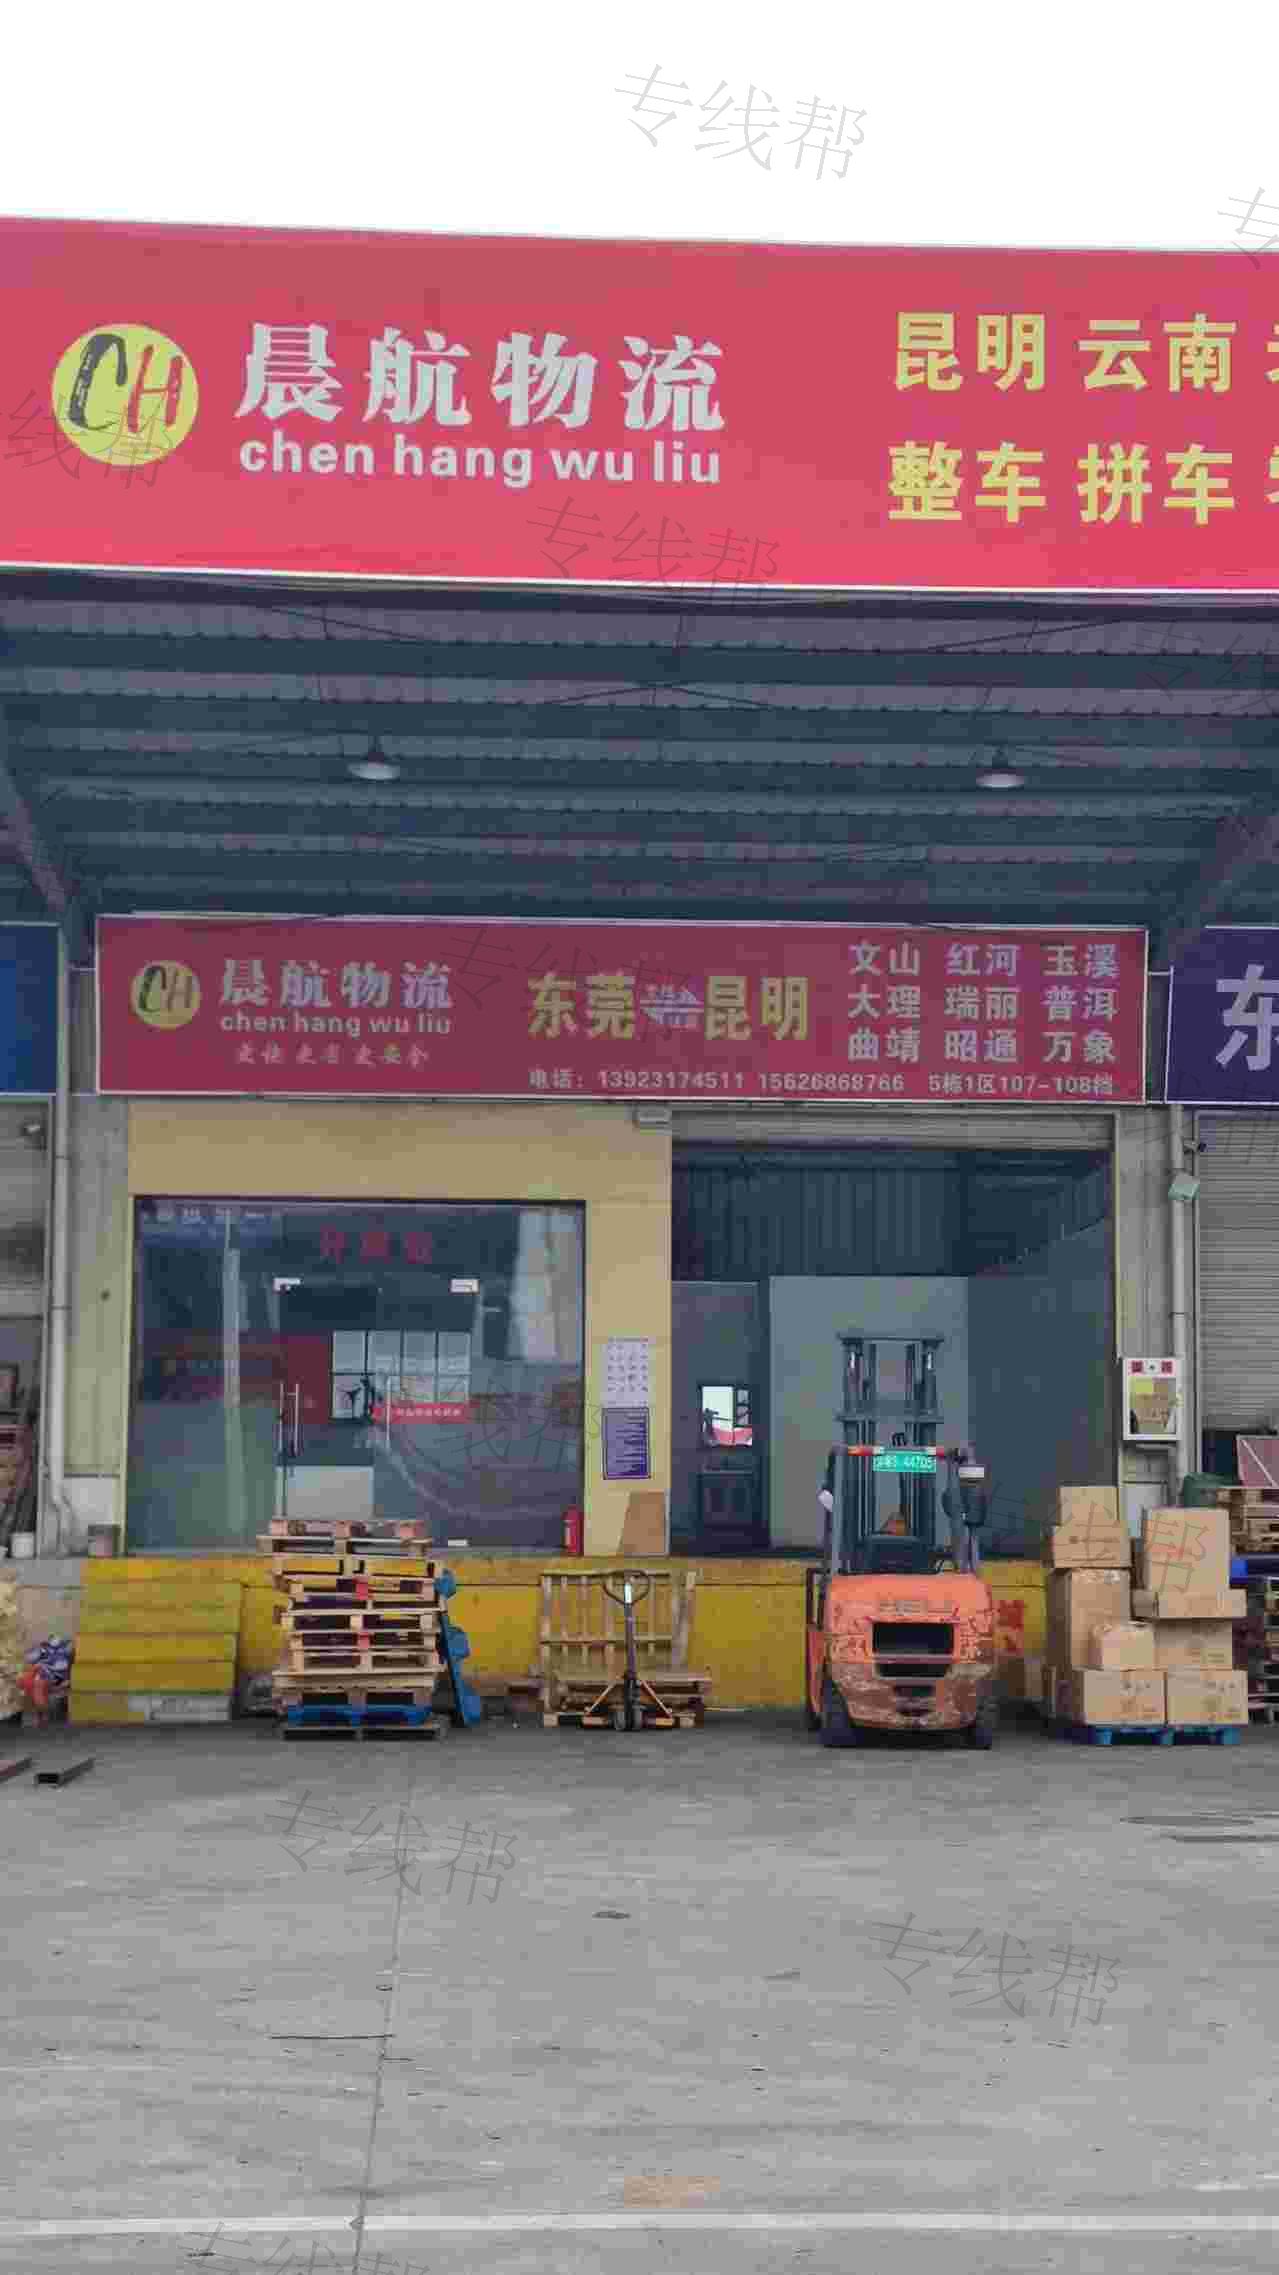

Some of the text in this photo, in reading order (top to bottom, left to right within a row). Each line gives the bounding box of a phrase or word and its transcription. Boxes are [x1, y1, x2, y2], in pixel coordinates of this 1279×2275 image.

[235, 323, 726, 432] 晨航物流
[895, 312, 1047, 392] 昆明
[1077, 313, 1238, 393] 云南
[239, 429, 721, 488] chen hang wu liu
[888, 441, 1047, 521] 整车
[1077, 442, 1236, 525] 拼车
[219, 958, 454, 1009] 晨航物流
[848, 940, 1120, 980] 文山 红河 玉溪
[220, 1010, 452, 1040] chen hang wu liu
[527, 971, 809, 1040] 东莞 昆明
[848, 983, 1118, 1021] 大理 瑞丽 普洱
[848, 1027, 1116, 1063] 曲靖 昭通 万象
